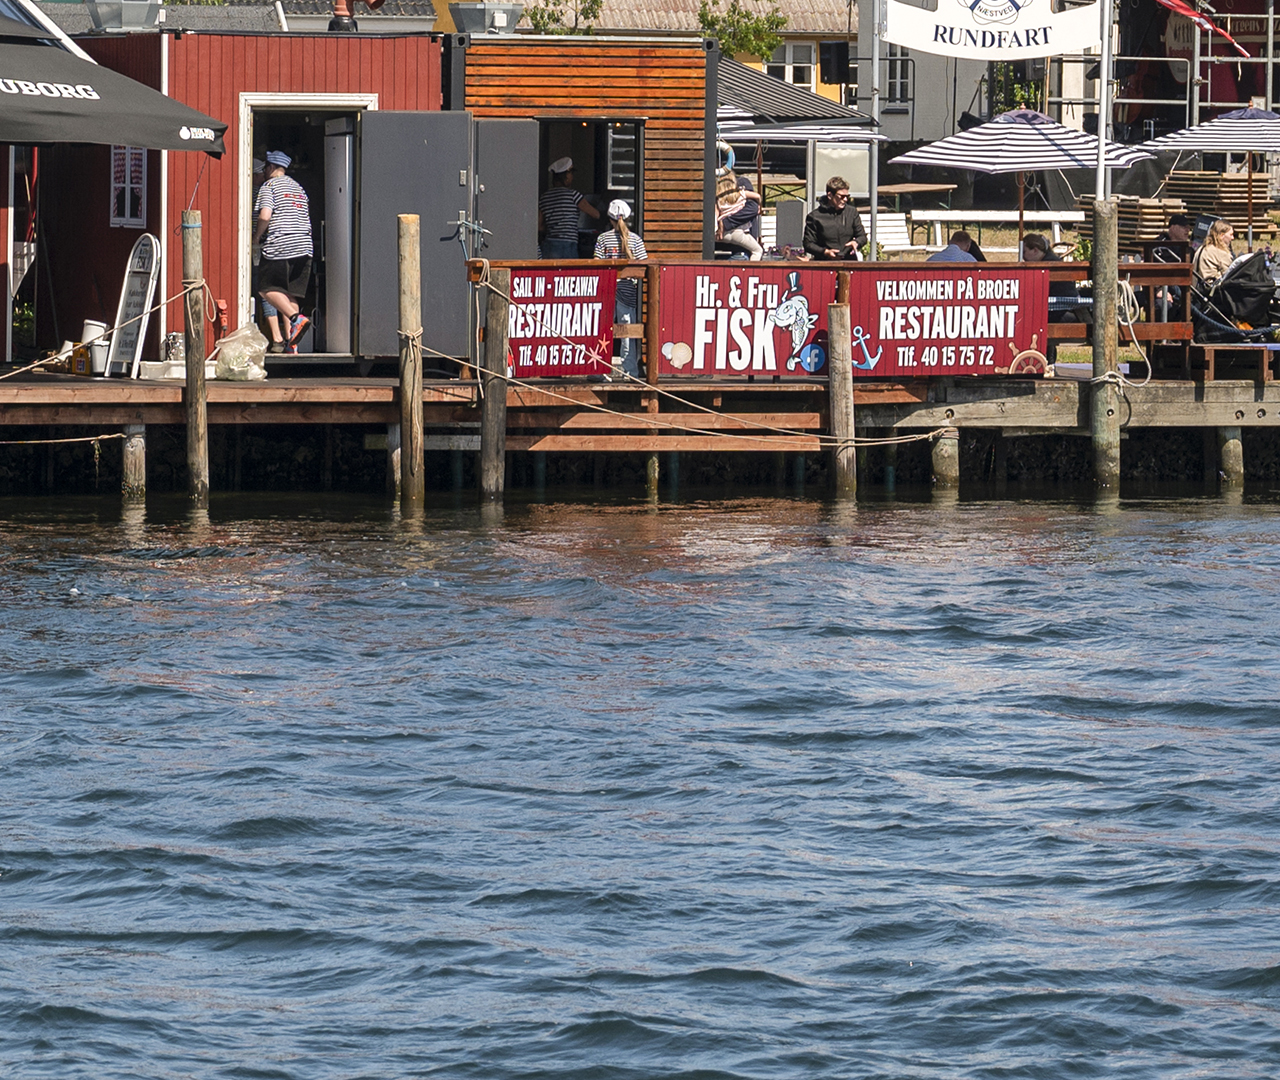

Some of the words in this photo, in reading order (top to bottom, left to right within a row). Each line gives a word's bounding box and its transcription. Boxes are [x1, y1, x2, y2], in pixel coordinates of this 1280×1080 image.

[976, 5, 1014, 17] NÆSTVED
[932, 24, 1053, 49] RUNDFART
[513, 277, 533, 298] SAIL
[535, 276, 545, 297] IN
[554, 276, 599, 297] TAKEAWAY
[696, 275, 722, 307] Hr.
[728, 275, 742, 308] &
[747, 276, 779, 308] Fru
[876, 279, 953, 301] VELKOMMEN
[957, 276, 974, 300] PÅ
[977, 279, 1020, 300] BROEN
[508, 302, 602, 338] RESTAURANT
[878, 305, 1019, 340] RESTAURANT
[693, 307, 777, 371] FISK
[519, 345, 533, 366] Tlf.
[535, 345, 547, 366] 40
[549, 345, 559, 365] 15
[561, 344, 572, 365] 75
[575, 344, 586, 365] 72
[897, 346, 918, 367] Tlf.
[921, 346, 938, 366] 40
[941, 346, 956, 366] 15
[959, 346, 975, 366] 75
[978, 345, 994, 365] 72
